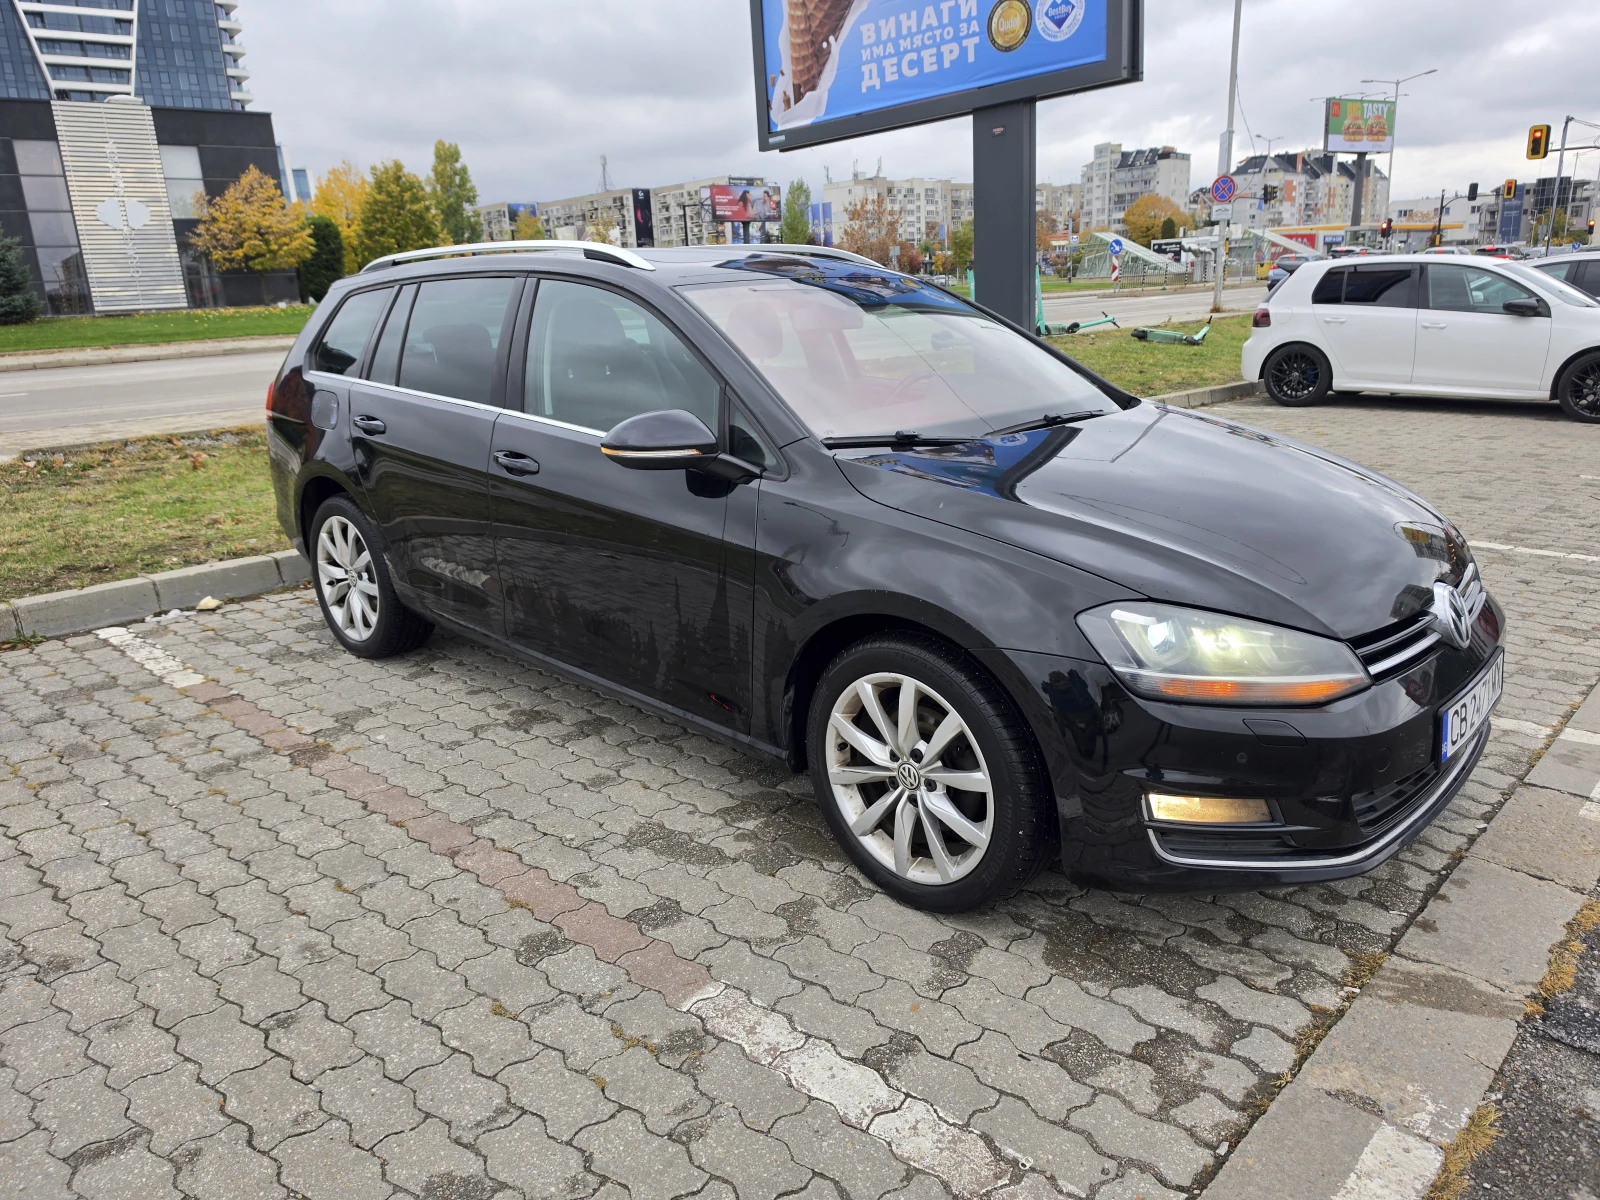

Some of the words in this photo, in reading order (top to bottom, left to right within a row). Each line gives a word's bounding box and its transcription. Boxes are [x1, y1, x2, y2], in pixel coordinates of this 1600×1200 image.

[860, 0, 978, 45] ВИНАГИ
[1048, 4, 1073, 17] BestBuy
[861, 42, 895, 61] ИМА
[899, 26, 955, 52] МЯСТО
[959, 20, 980, 36] ЗА
[861, 36, 980, 93] ДЕСЕРТ
[1347, 102, 1361, 118] BIG
[1363, 103, 1389, 119] TASTY
[1450, 703, 1468, 746] CB
